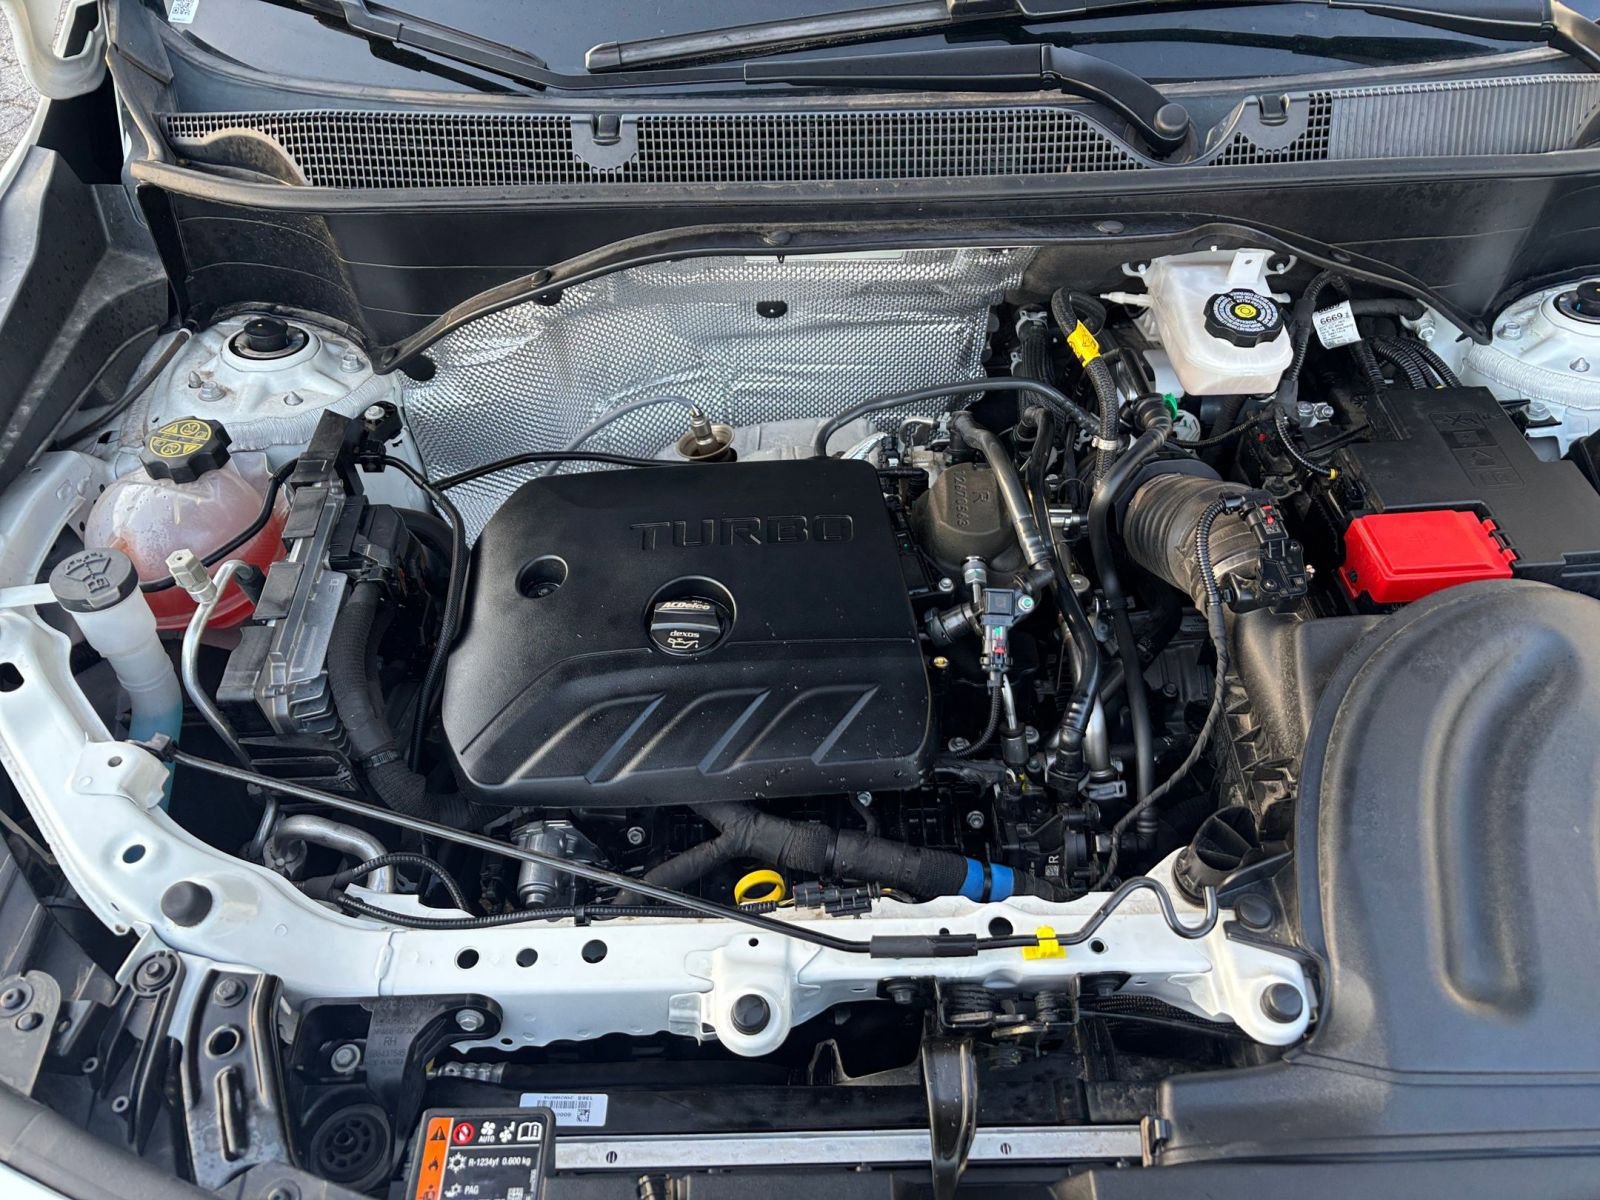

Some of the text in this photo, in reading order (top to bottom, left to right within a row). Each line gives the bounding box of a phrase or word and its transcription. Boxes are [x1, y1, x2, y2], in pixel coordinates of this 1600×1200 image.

[1320, 312, 1343, 325] 6669
[630, 514, 854, 550] TURBO
[661, 601, 711, 610] ACDelco
[669, 630, 700, 638] dexos
[1048, 855, 1060, 864] R
[383, 1036, 398, 1047] RH
[478, 1135, 496, 1143] AUTO
[467, 1156, 532, 1168] R-1234yf 0.600 kg
[463, 1185, 479, 1195] PAG
